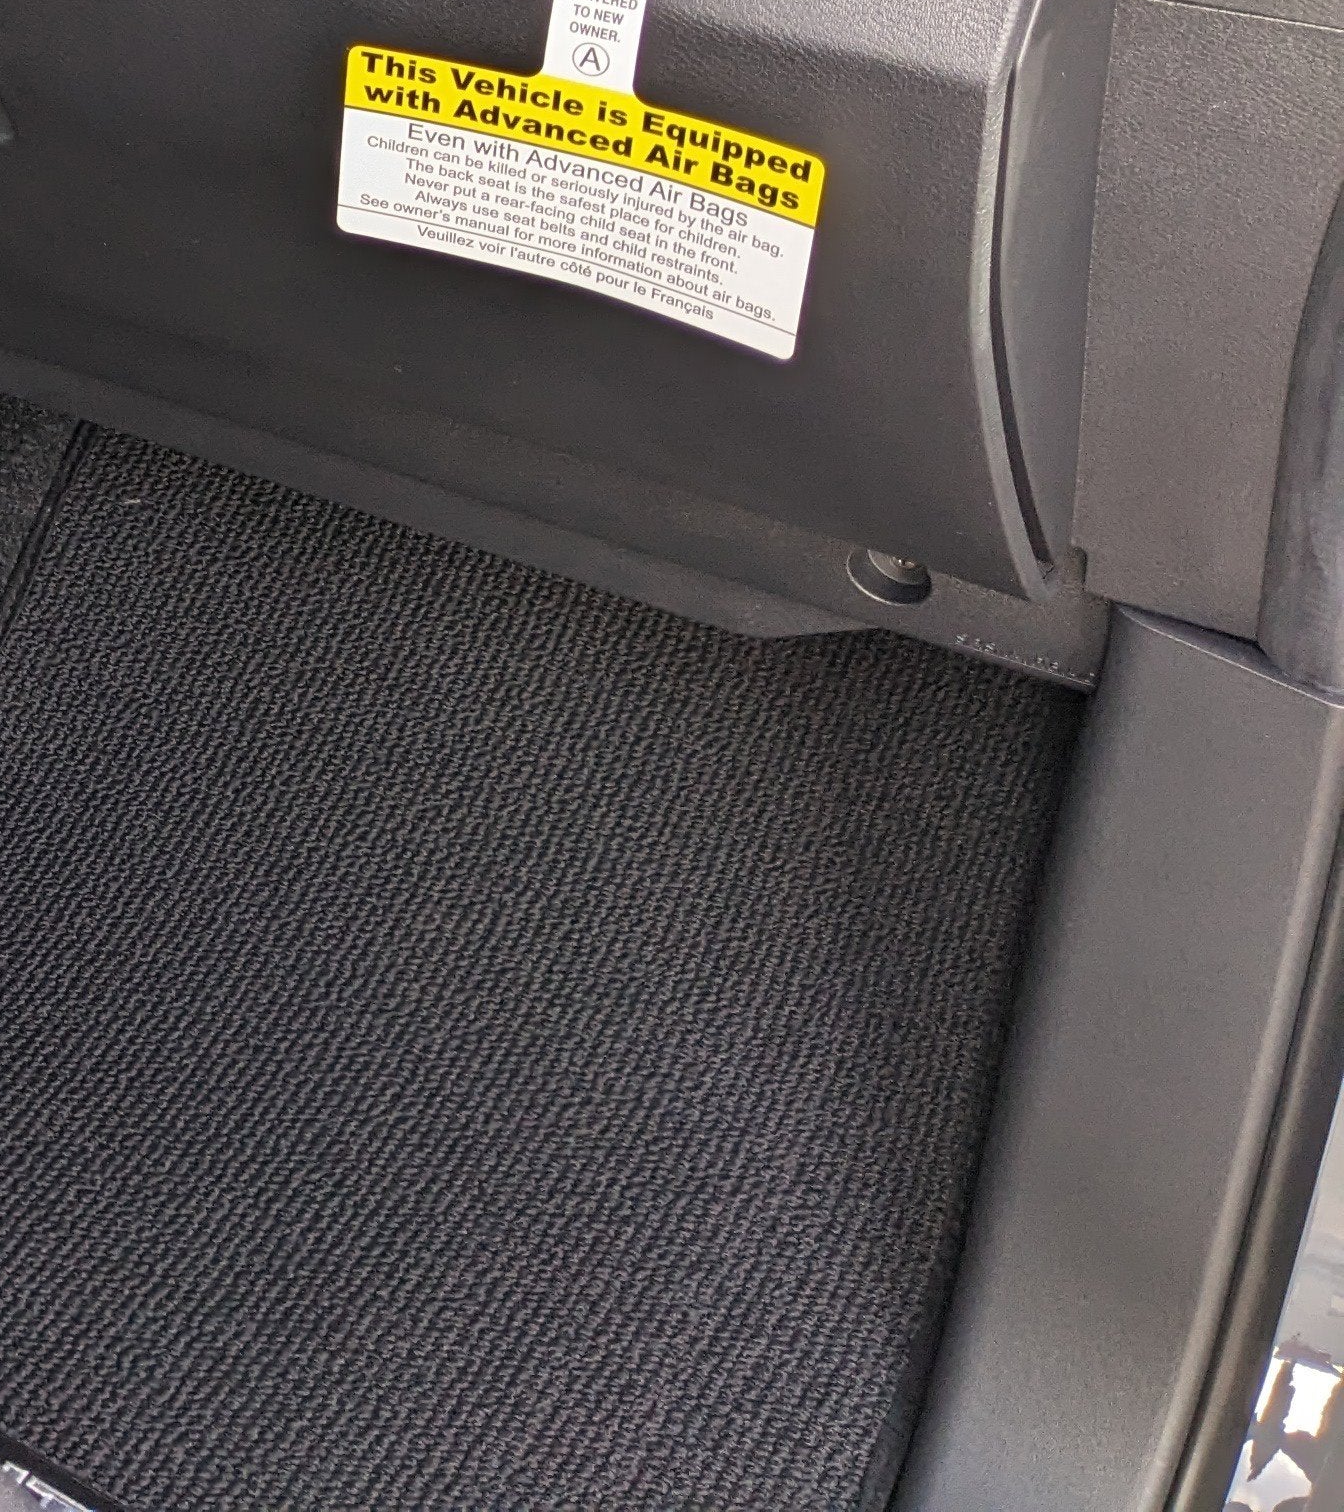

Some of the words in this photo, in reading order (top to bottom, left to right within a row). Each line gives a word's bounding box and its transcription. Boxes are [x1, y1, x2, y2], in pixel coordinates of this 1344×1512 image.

[569, 21, 621, 43] OWNER.
[574, 4, 590, 18] TO
[594, 8, 624, 25] NEW
[579, 47, 601, 71] A
[361, 51, 437, 84] This
[450, 67, 584, 116] Vehicle
[598, 100, 628, 126] is
[642, 111, 812, 183] Equipped
[364, 86, 440, 114] with
[453, 98, 633, 158] Advanced
[645, 144, 699, 175] Air
[710, 160, 799, 209] Bags
[367, 136, 428, 157] Children
[434, 150, 460, 164] can
[465, 155, 483, 169] be
[489, 160, 526, 179] killed
[531, 173, 547, 184] or
[551, 176, 619, 204] seriously
[623, 193, 674, 219] injured
[678, 210, 696, 228] by
[700, 218, 724, 235] the
[728, 230, 748, 243] air
[752, 235, 784, 257] bag.
[405, 173, 450, 192] Never
[453, 185, 476, 198] put
[481, 191, 490, 201] a
[495, 194, 575, 224] rear-facing
[580, 214, 615, 232] child
[619, 226, 651, 244] seat
[655, 235, 668, 250] in
[673, 242, 696, 259] the
[701, 250, 738, 274] front.
[406, 158, 434, 173] The
[439, 164, 474, 183] back
[478, 175, 510, 191] seat
[515, 182, 527, 194] is
[532, 187, 555, 201] the
[560, 195, 606, 214] safest
[610, 207, 649, 227] place
[655, 219, 674, 235] for
[678, 229, 740, 259] children.
[408, 123, 465, 150] Even
[474, 140, 519, 162] with
[525, 149, 644, 193] Advanced
[649, 180, 683, 204] Air
[690, 192, 748, 226] Bags
[360, 193, 389, 209] See
[394, 202, 450, 222] owner's
[455, 215, 510, 236] manual
[514, 227, 534, 241] for
[538, 235, 576, 252] more
[581, 244, 663, 280] information
[667, 273, 709, 297] about
[713, 290, 732, 303] air
[736, 296, 775, 321] bags.
[415, 190, 467, 212] Always
[473, 205, 499, 218] use
[504, 212, 535, 227] seat
[540, 219, 576, 237] belts
[580, 231, 608, 246] and
[613, 239, 647, 259] child
[651, 251, 723, 285] restraints.
[418, 225, 474, 248] Veuillez
[479, 241, 506, 255] voir
[510, 246, 556, 267] l'autre
[560, 261, 592, 277] côté
[596, 272, 630, 288] pour
[634, 282, 646, 295] le
[651, 288, 714, 320] Français
